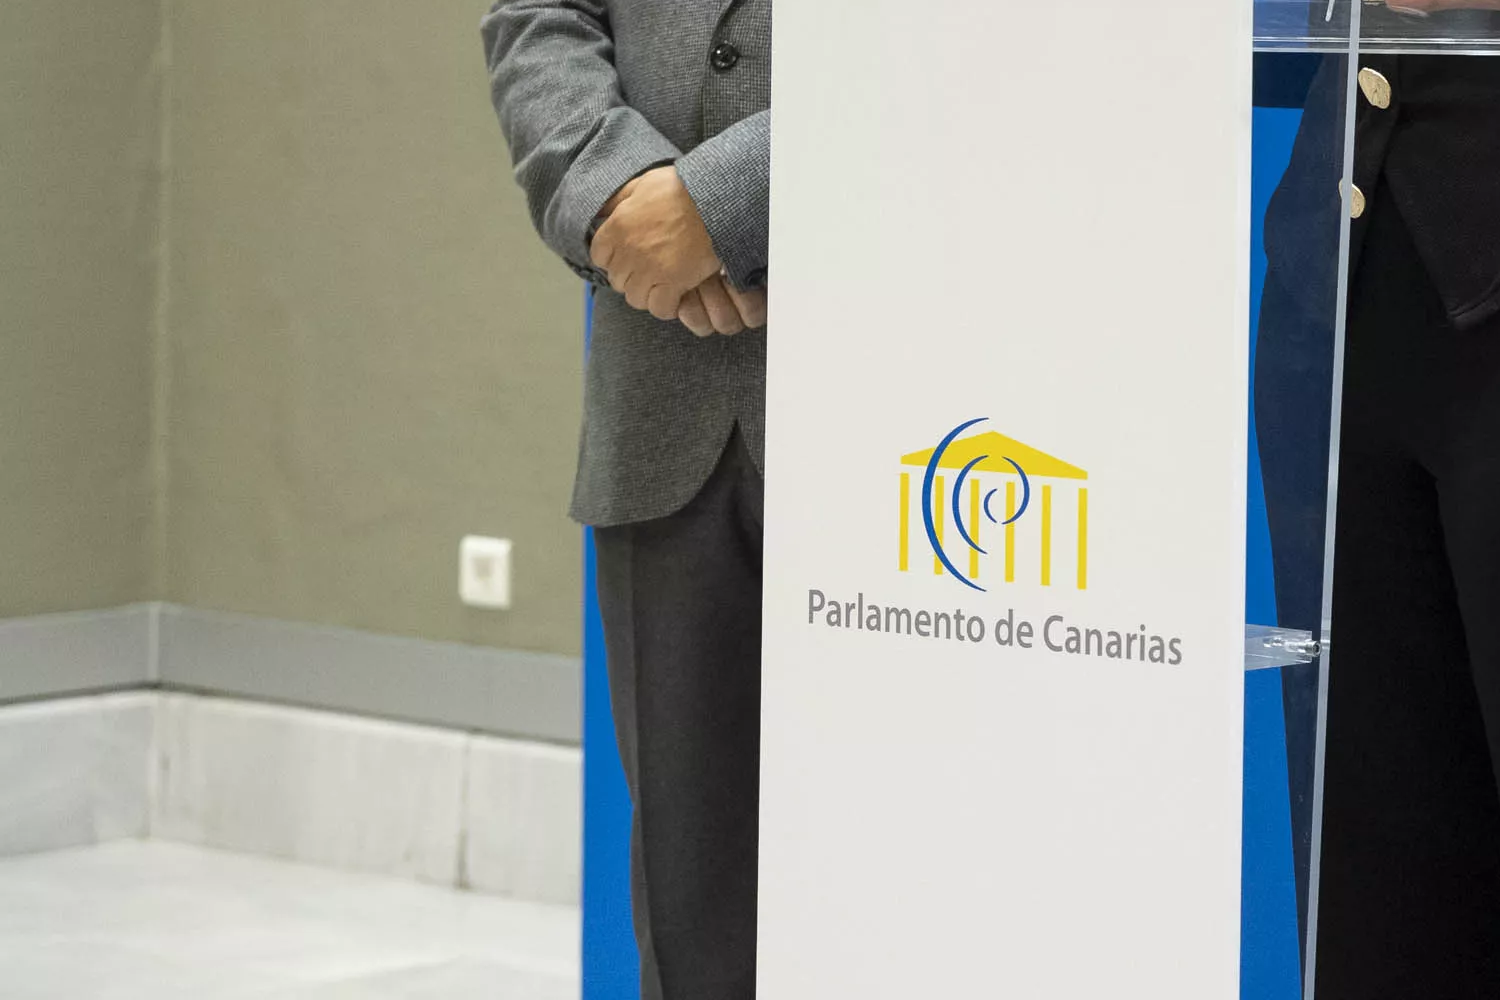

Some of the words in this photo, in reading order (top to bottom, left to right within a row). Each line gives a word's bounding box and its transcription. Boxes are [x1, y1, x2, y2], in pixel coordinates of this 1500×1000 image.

[807, 588, 986, 643] Parlamento
[994, 608, 1035, 649] de
[1042, 614, 1183, 666] Canarias
